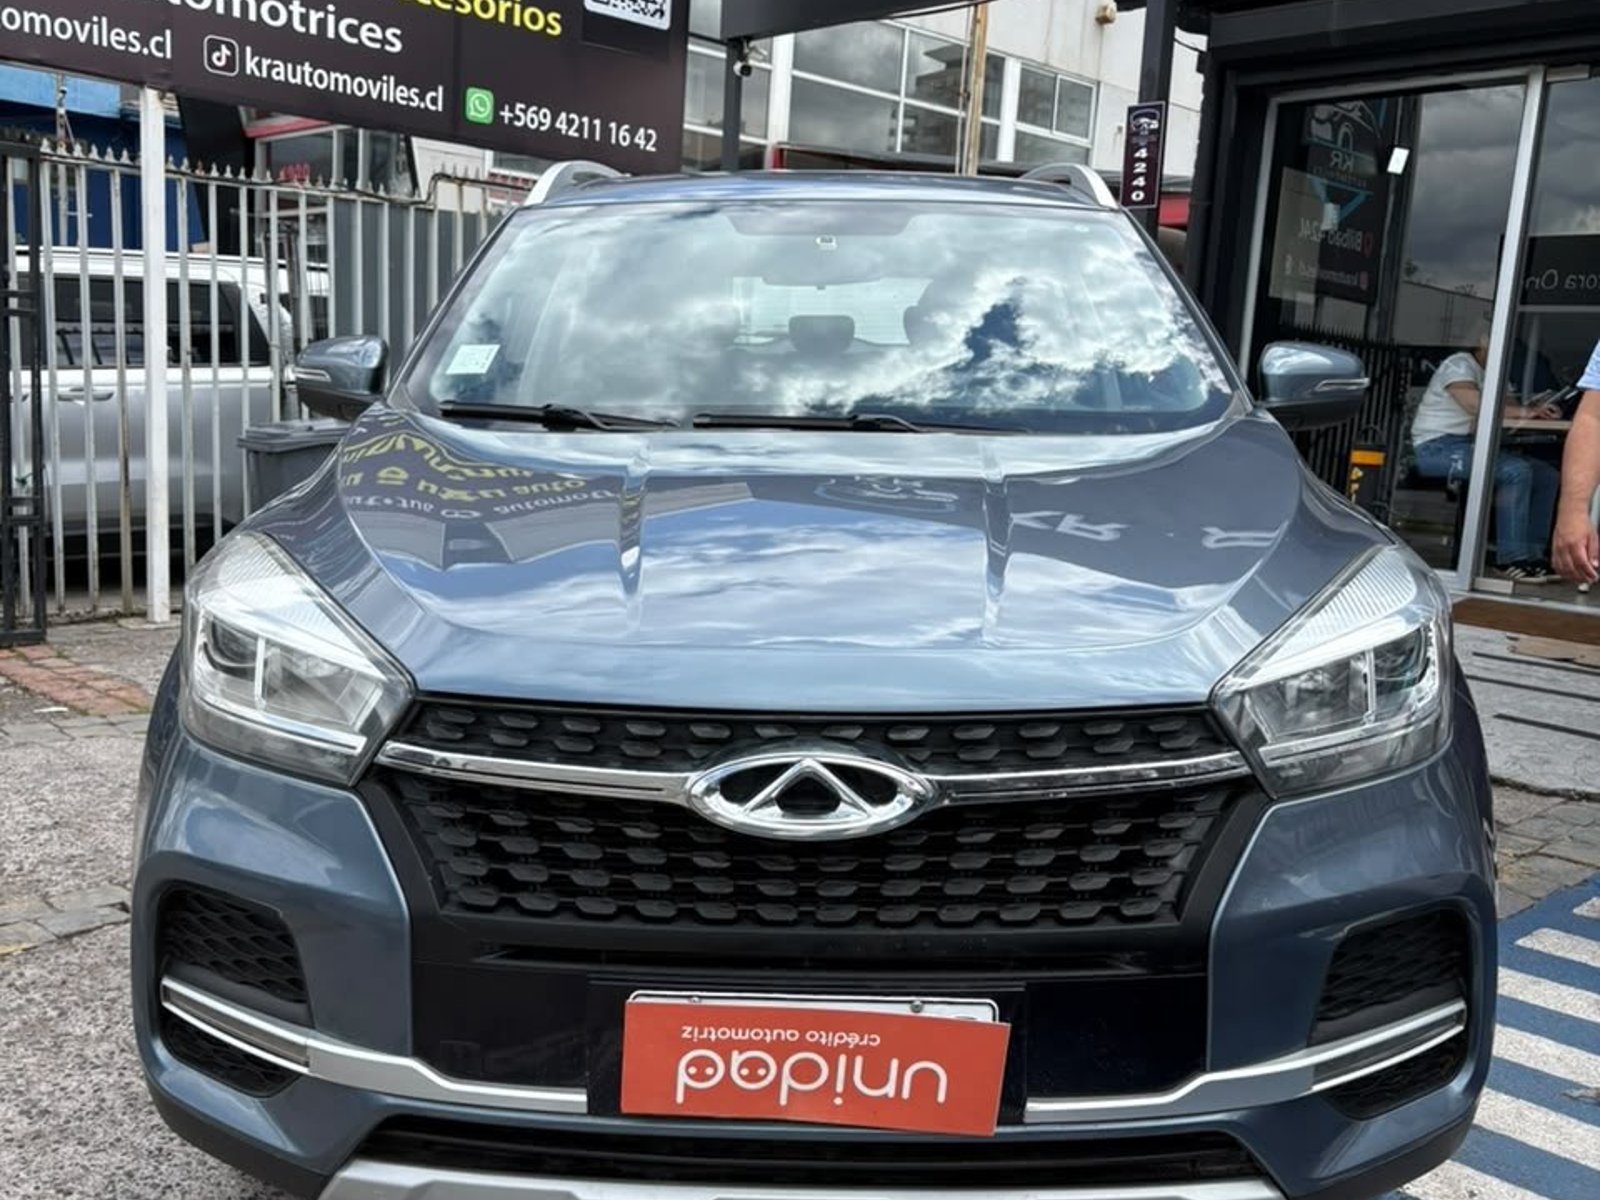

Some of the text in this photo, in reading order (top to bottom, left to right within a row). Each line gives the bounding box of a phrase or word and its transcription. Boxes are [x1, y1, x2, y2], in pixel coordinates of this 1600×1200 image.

[245, 46, 444, 112] krautomoviles.cl
[499, 102, 552, 131] +569
[555, 111, 601, 142] 4211
[1131, 147, 1148, 202] 4240
[680, 1025, 881, 1047] crédito automotriz
[675, 1048, 949, 1107] unidad
